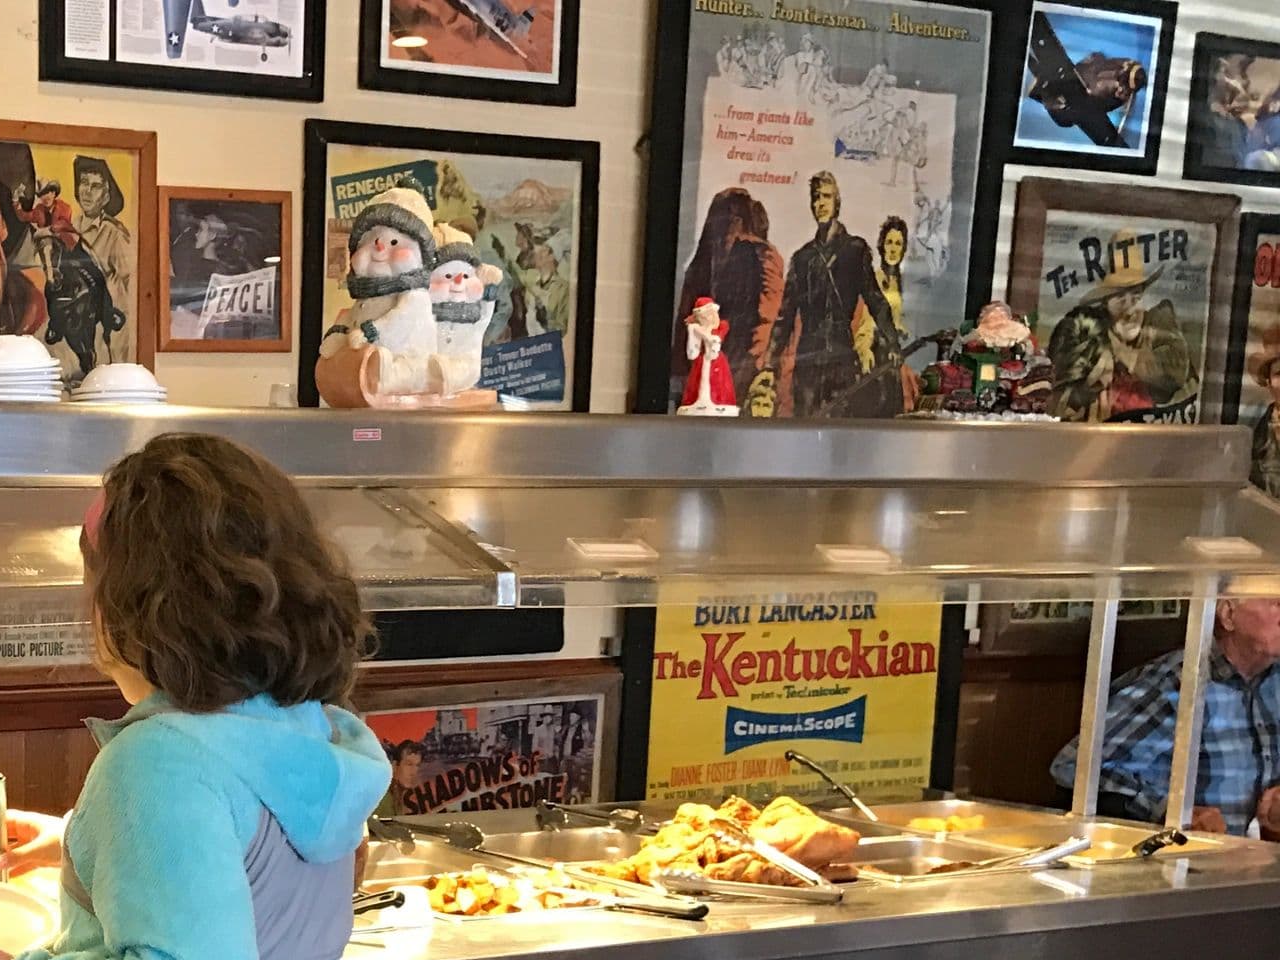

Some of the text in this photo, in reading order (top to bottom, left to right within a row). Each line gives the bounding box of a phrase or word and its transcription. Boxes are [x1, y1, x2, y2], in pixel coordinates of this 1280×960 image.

[757, 112, 790, 125] giants
[793, 110, 815, 126] like
[1079, 229, 1189, 283] RITTER
[203, 281, 273, 315] PEACE!
[694, 590, 878, 627] BURT LANCASTER
[30, 641, 65, 656] PICTURE
[654, 628, 937, 700] The Kentuckian
[402, 752, 515, 815] SHADOWS
[670, 764, 704, 788] DIANNE
[706, 760, 738, 783] FOSTER
